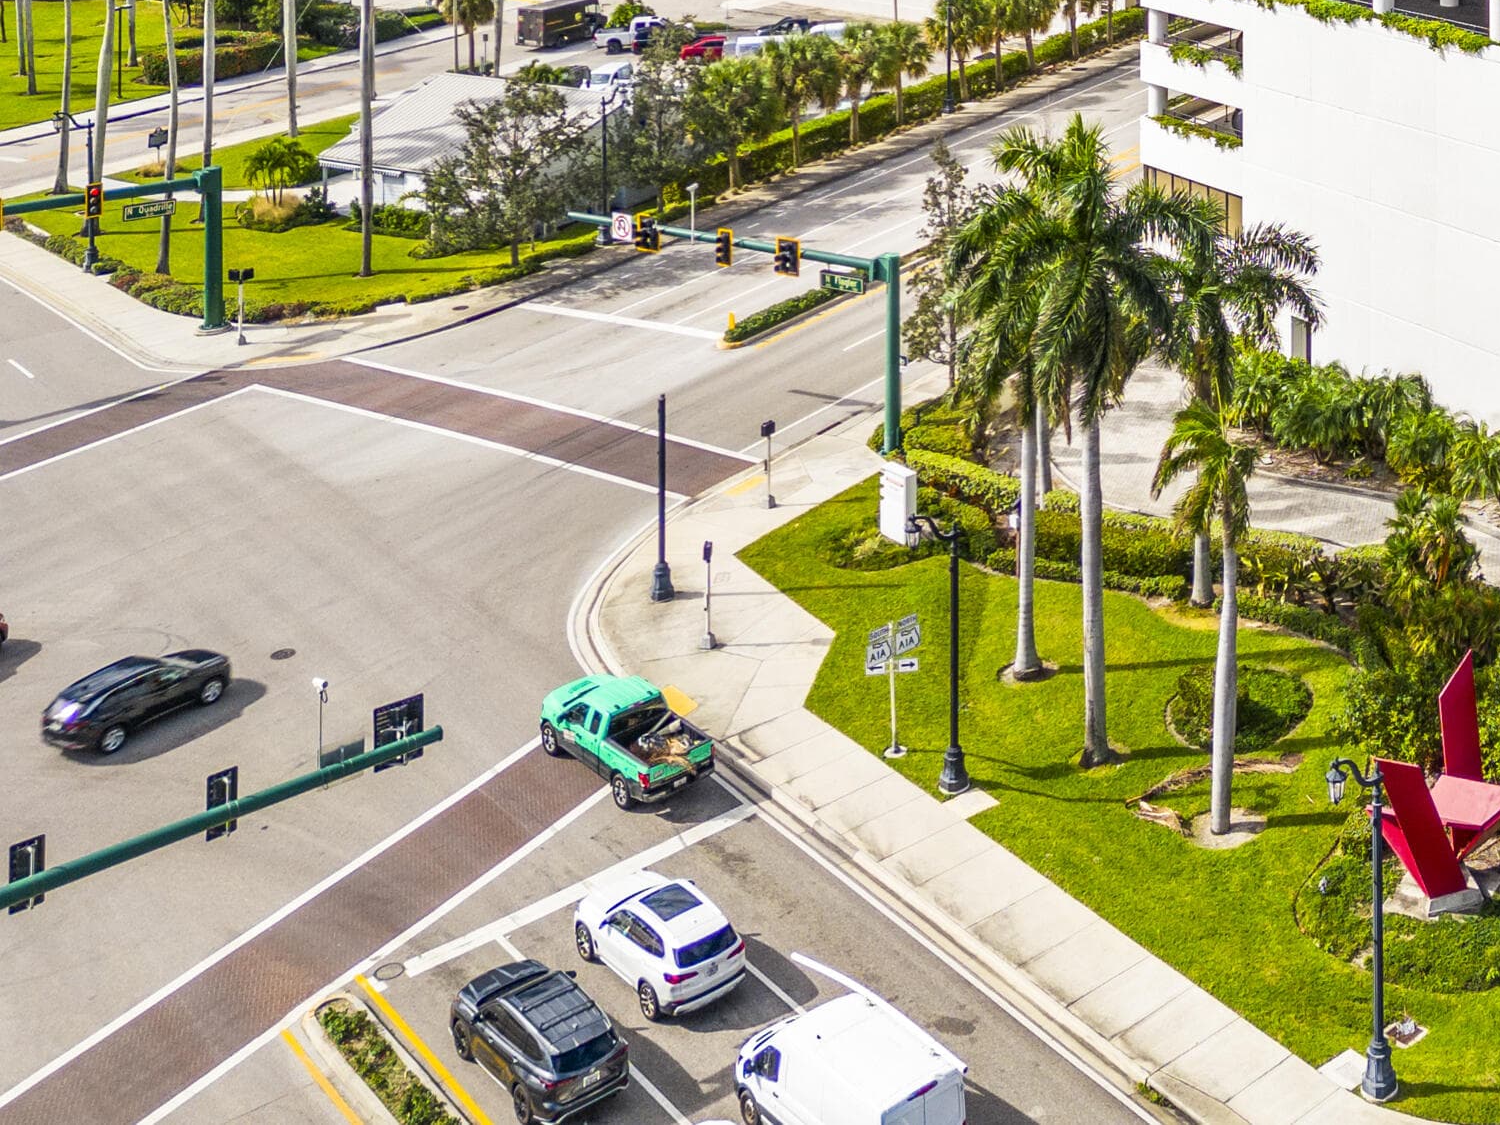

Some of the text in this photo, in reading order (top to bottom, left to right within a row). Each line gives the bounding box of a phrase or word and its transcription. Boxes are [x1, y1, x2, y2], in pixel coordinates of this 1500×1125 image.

[138, 202, 173, 214] Quadrille
[899, 636, 915, 650] A1A
[870, 648, 886, 663] A1A
